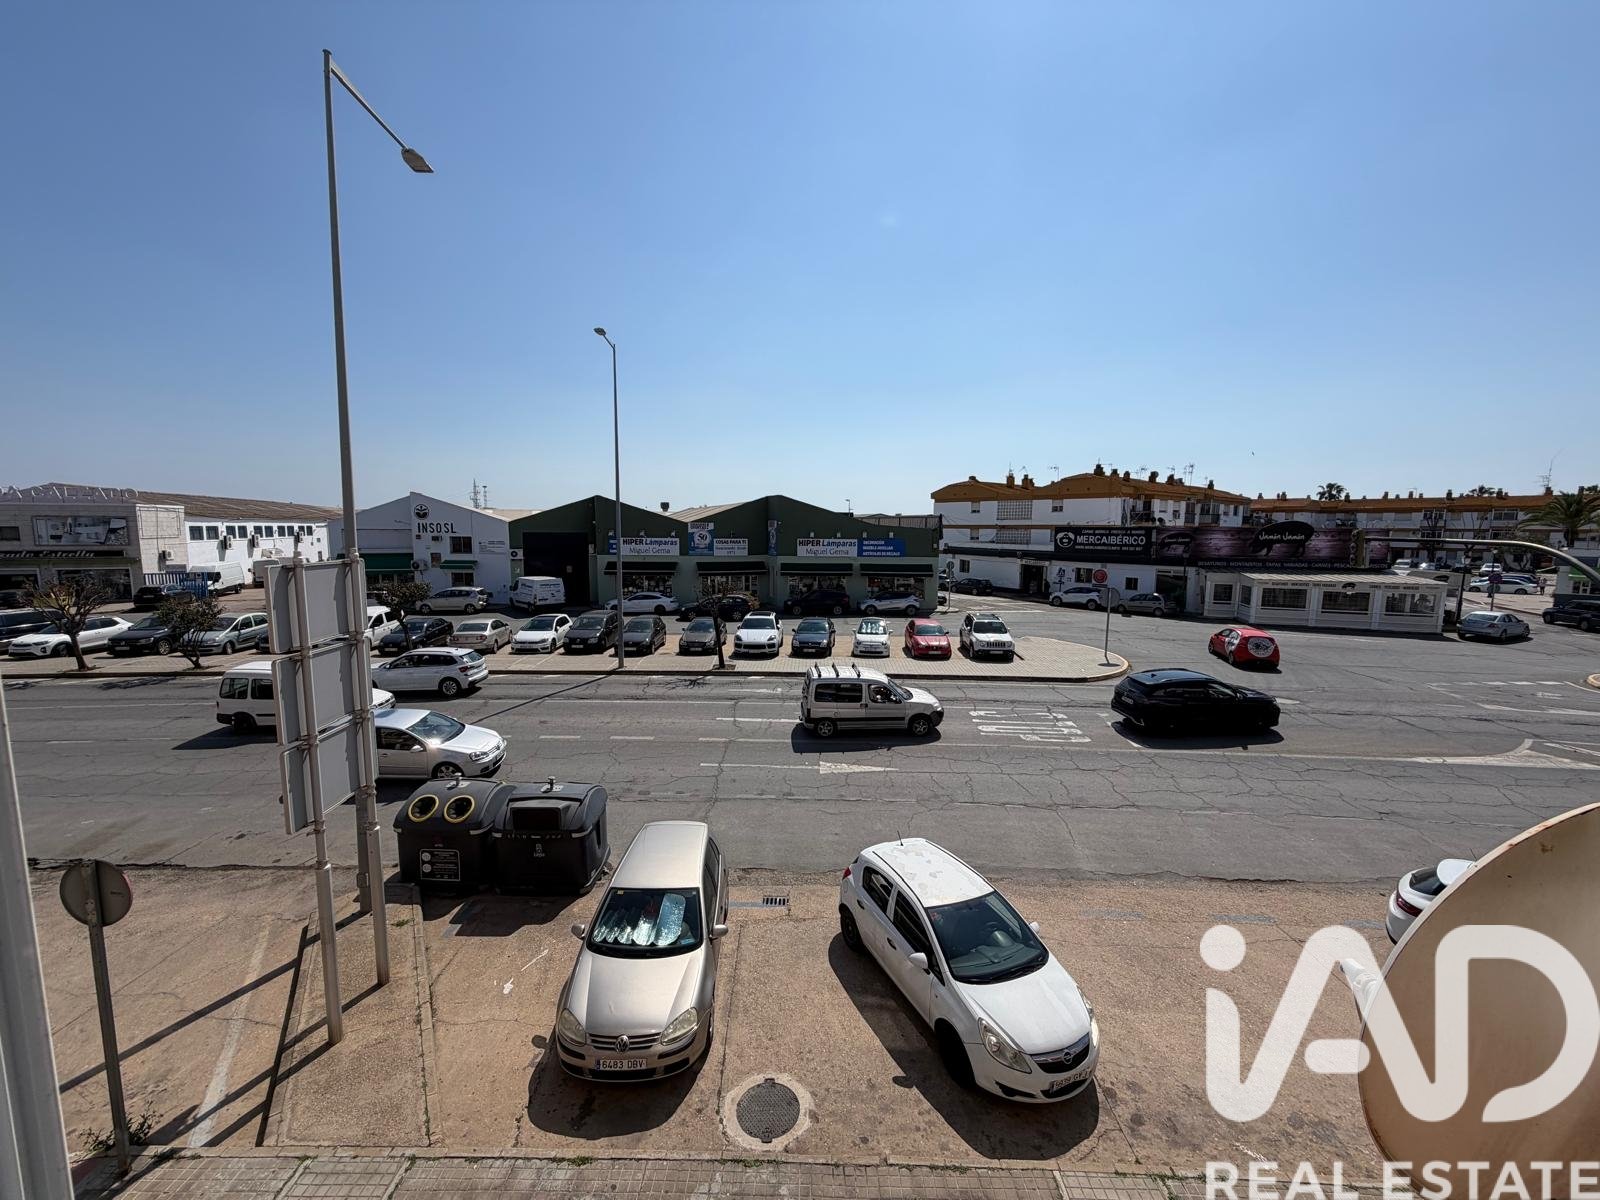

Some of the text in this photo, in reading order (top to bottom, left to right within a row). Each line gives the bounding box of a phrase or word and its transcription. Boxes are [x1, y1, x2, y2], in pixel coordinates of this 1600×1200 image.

[1076, 534, 1146, 545] MERCAIBÉRICO
[629, 547, 651, 555] Miguel
[806, 548, 828, 556] Miguel
[602, 1060, 644, 1069] 6483 DBV
